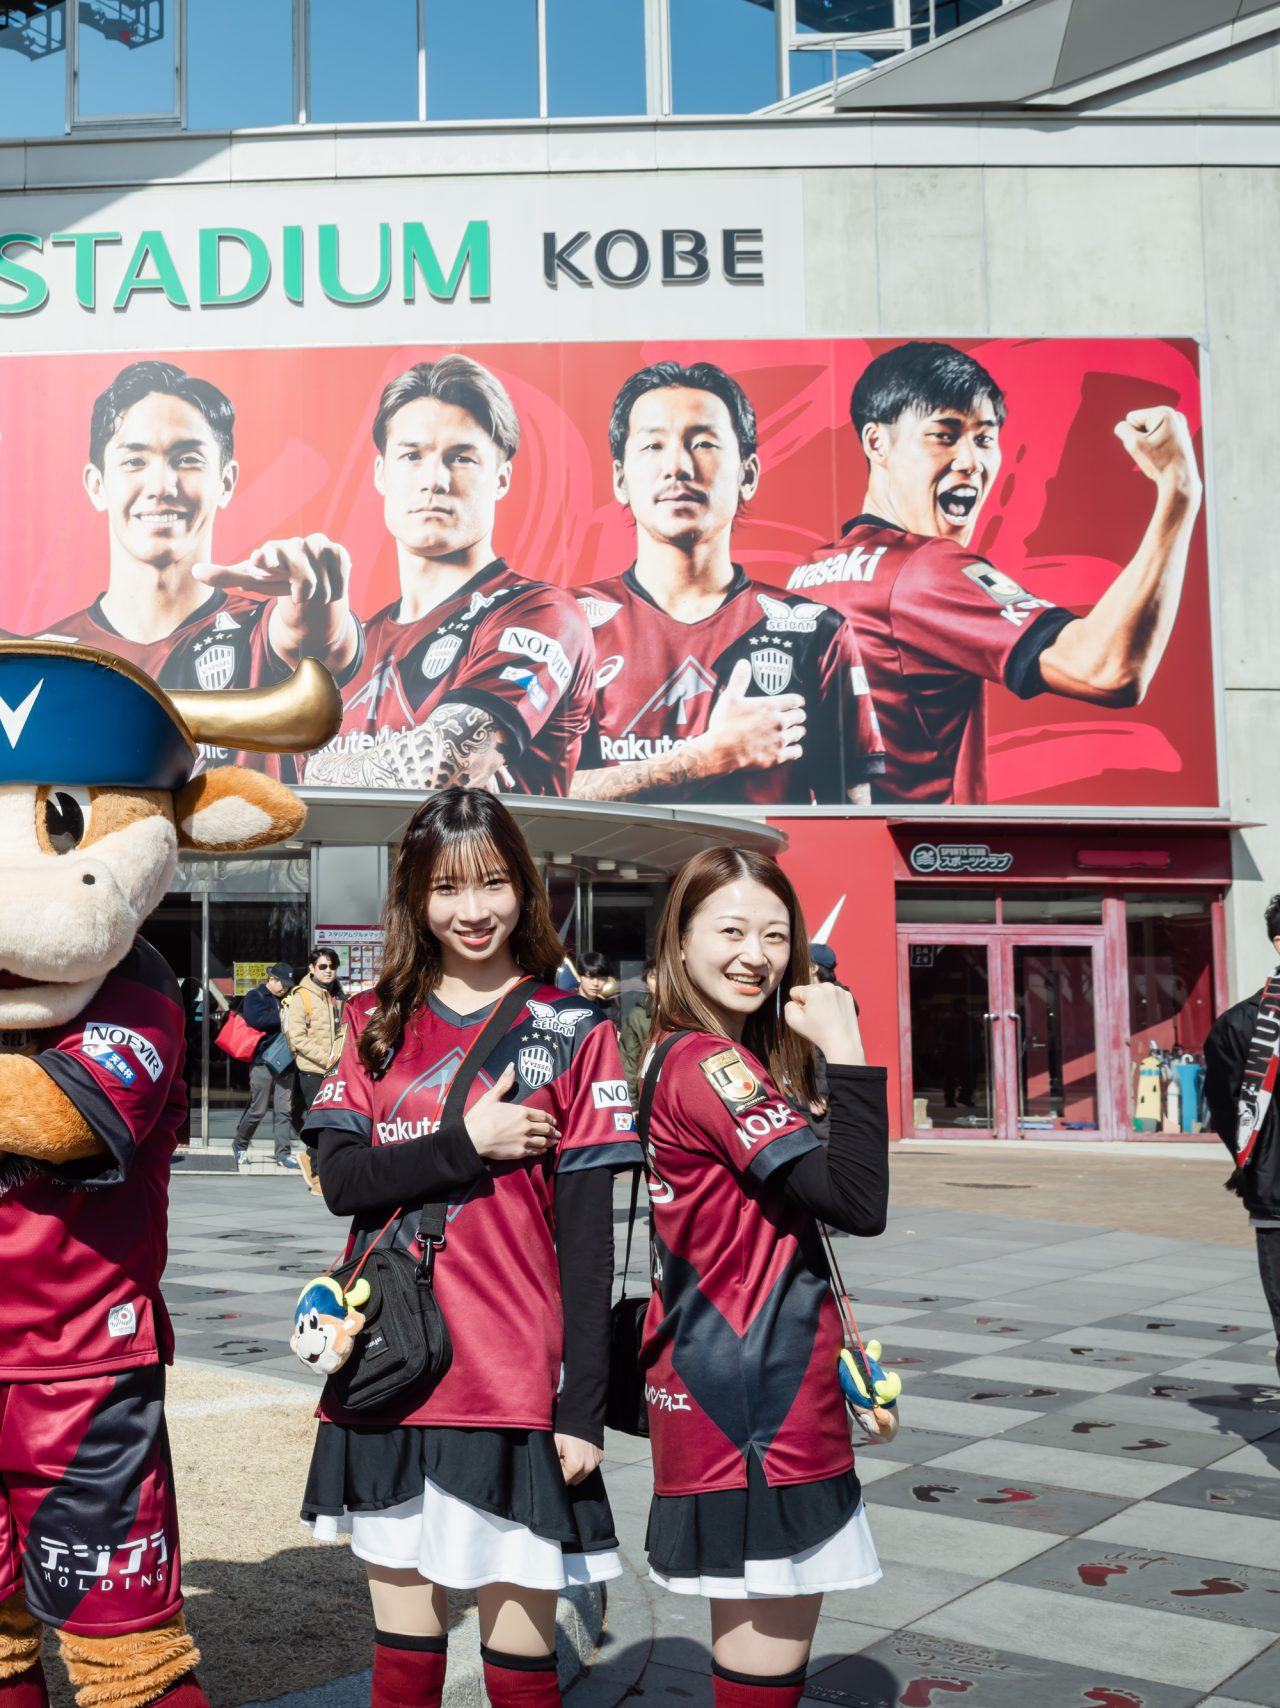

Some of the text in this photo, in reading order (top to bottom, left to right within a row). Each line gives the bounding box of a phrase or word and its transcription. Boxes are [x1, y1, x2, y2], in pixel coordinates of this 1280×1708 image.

[541, 226, 765, 289] KOBE
[940, 847, 967, 856] SPORTS
[941, 856, 1009, 867] スポーツクラブ
